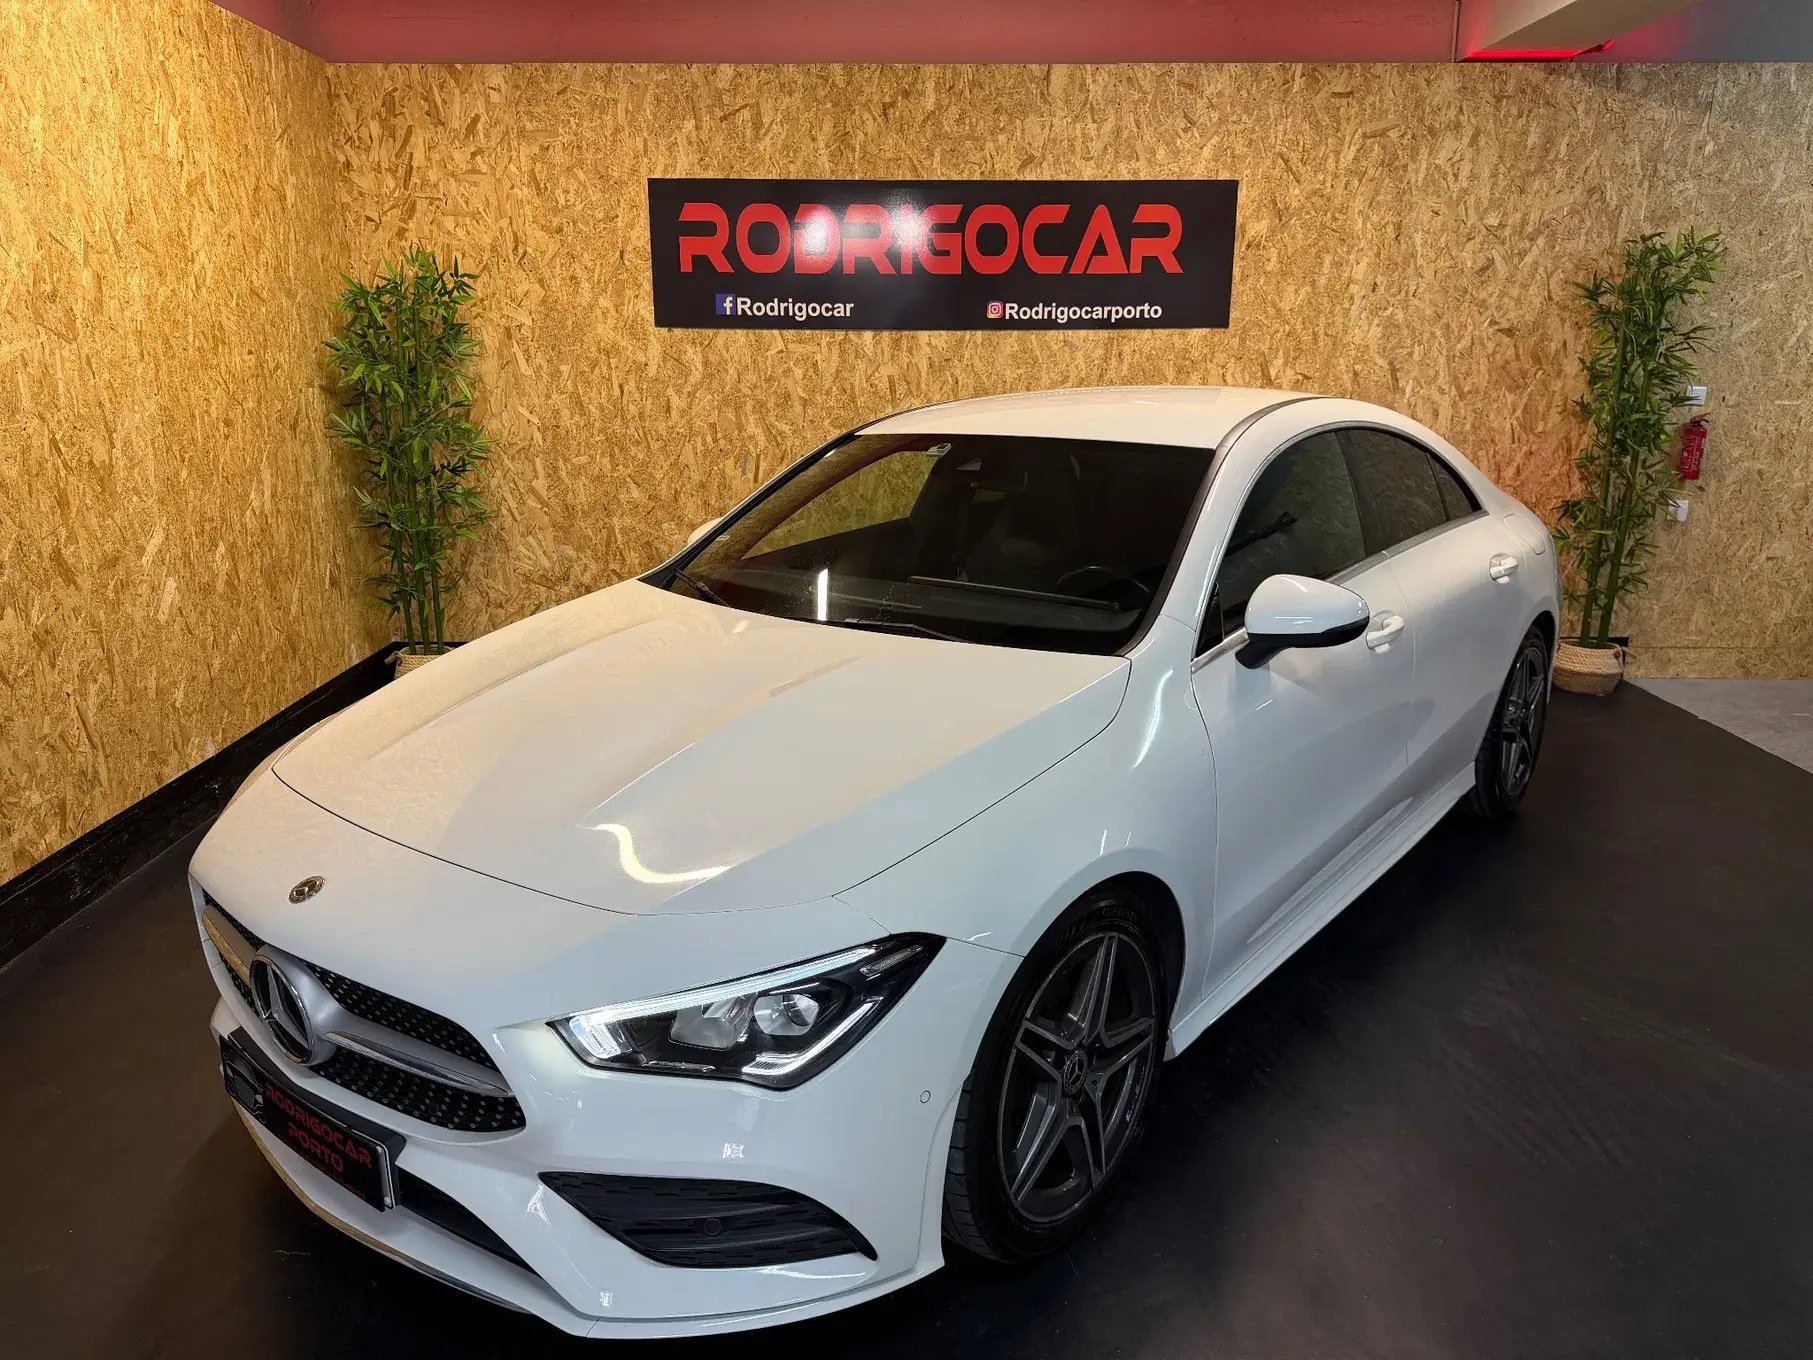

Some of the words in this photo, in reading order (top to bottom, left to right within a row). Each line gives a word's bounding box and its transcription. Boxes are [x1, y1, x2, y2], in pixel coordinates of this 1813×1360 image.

[678, 202, 1184, 275] RODRIGOCAR
[736, 297, 855, 322] Rodrigocar
[1005, 302, 1163, 324] Rodrigocarporto
[264, 1087, 373, 1169] RODRIGOCAR
[287, 1121, 344, 1172] PORTO
